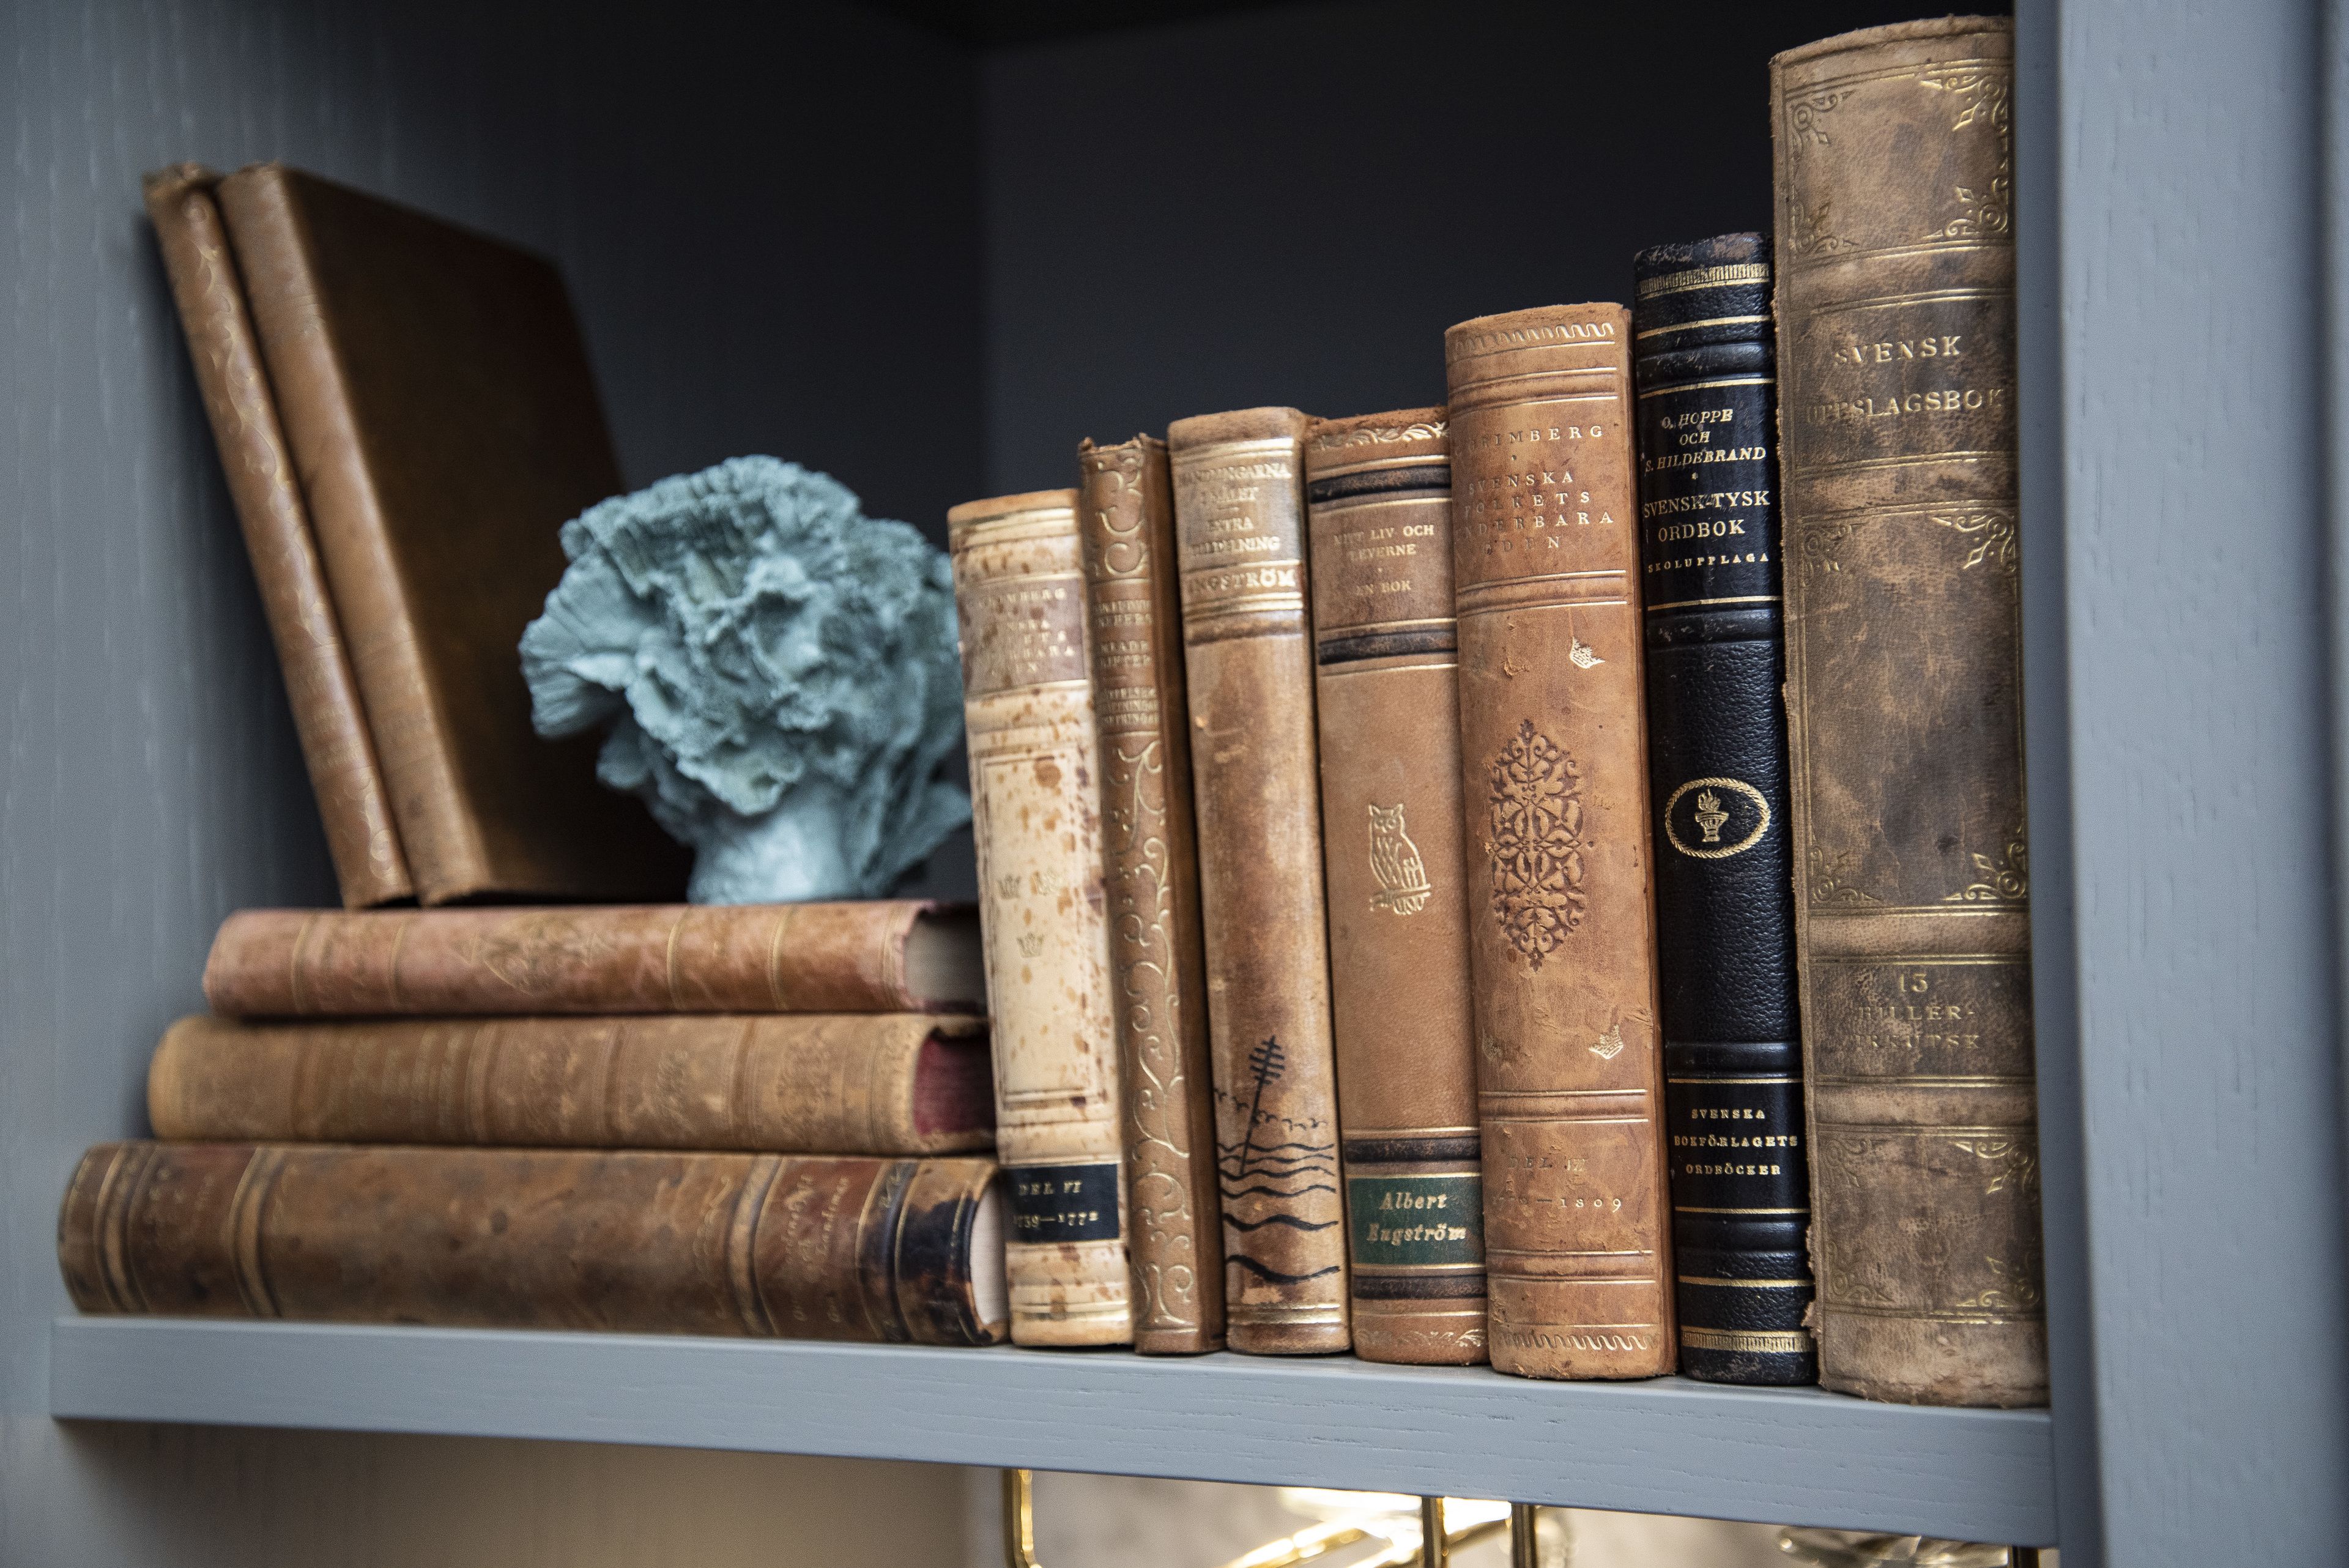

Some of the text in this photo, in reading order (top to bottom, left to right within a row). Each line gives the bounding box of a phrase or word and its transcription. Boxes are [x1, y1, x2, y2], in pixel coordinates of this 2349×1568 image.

[1835, 335, 1961, 366] SVENSK
[1679, 409, 1733, 426] HOPPE
[1679, 431, 1710, 445] OCH
[1657, 447, 1767, 470] HILDEBRAND
[1469, 471, 1574, 496] SVENSKA
[1643, 490, 1770, 518] SVENSK-TYSK
[1370, 527, 1395, 540] LIV
[1403, 524, 1434, 537] OCH
[1463, 511, 1614, 538] NDERBARA
[1658, 519, 1745, 543] ORDBOK
[1648, 552, 1769, 574] SKOLUPPLAGA
[1691, 1109, 1765, 1120] SVENSKA
[1674, 1134, 1798, 1148] BOKFÖRLAGETS
[1686, 1162, 1781, 1176] ORDBÖCKER
[1379, 1191, 1448, 1211] Albert
[1366, 1223, 1468, 1247] Engström
